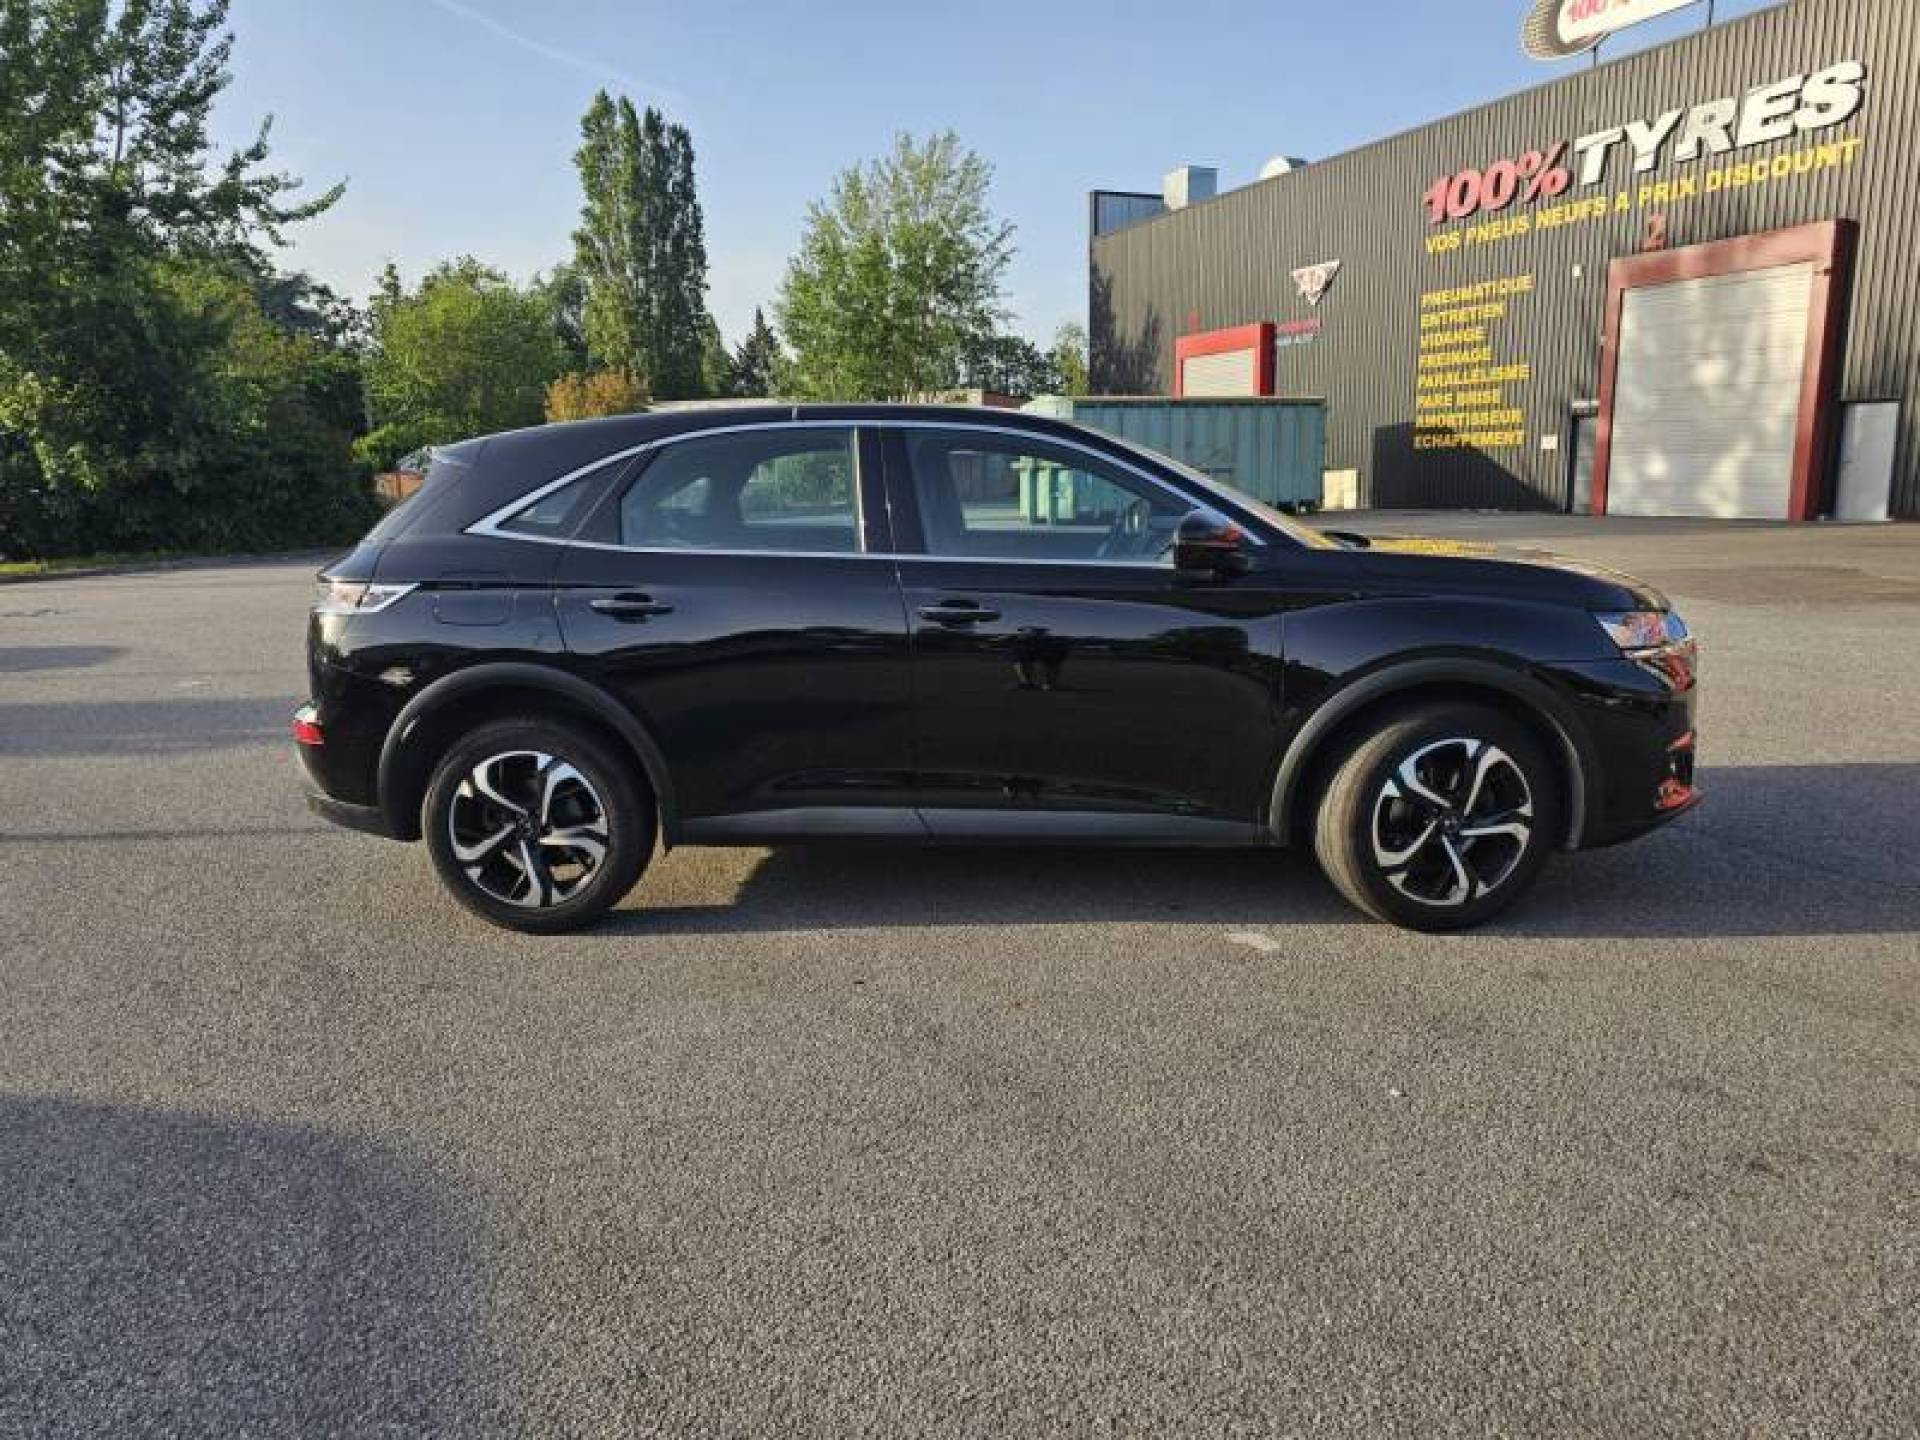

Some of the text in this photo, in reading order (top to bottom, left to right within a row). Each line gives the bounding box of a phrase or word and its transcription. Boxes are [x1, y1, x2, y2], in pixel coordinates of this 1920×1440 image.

[1425, 61, 1866, 224] 100% TYRES
[1426, 138, 1862, 254] VOS PNEUS NEUFS A PRIX DISCOUNT
[1641, 213, 1667, 249] 2
[1421, 275, 1535, 307] PNEUMATIQUE
[1420, 302, 1505, 329] ENTRETIEN
[1420, 326, 1488, 348] VIDANGE
[1419, 346, 1492, 368] FREINAGE
[1416, 393, 1453, 408] PARE
[1416, 409, 1525, 428] AMORTISSEUR
[1414, 430, 1525, 449] ECHAPPEMENT
